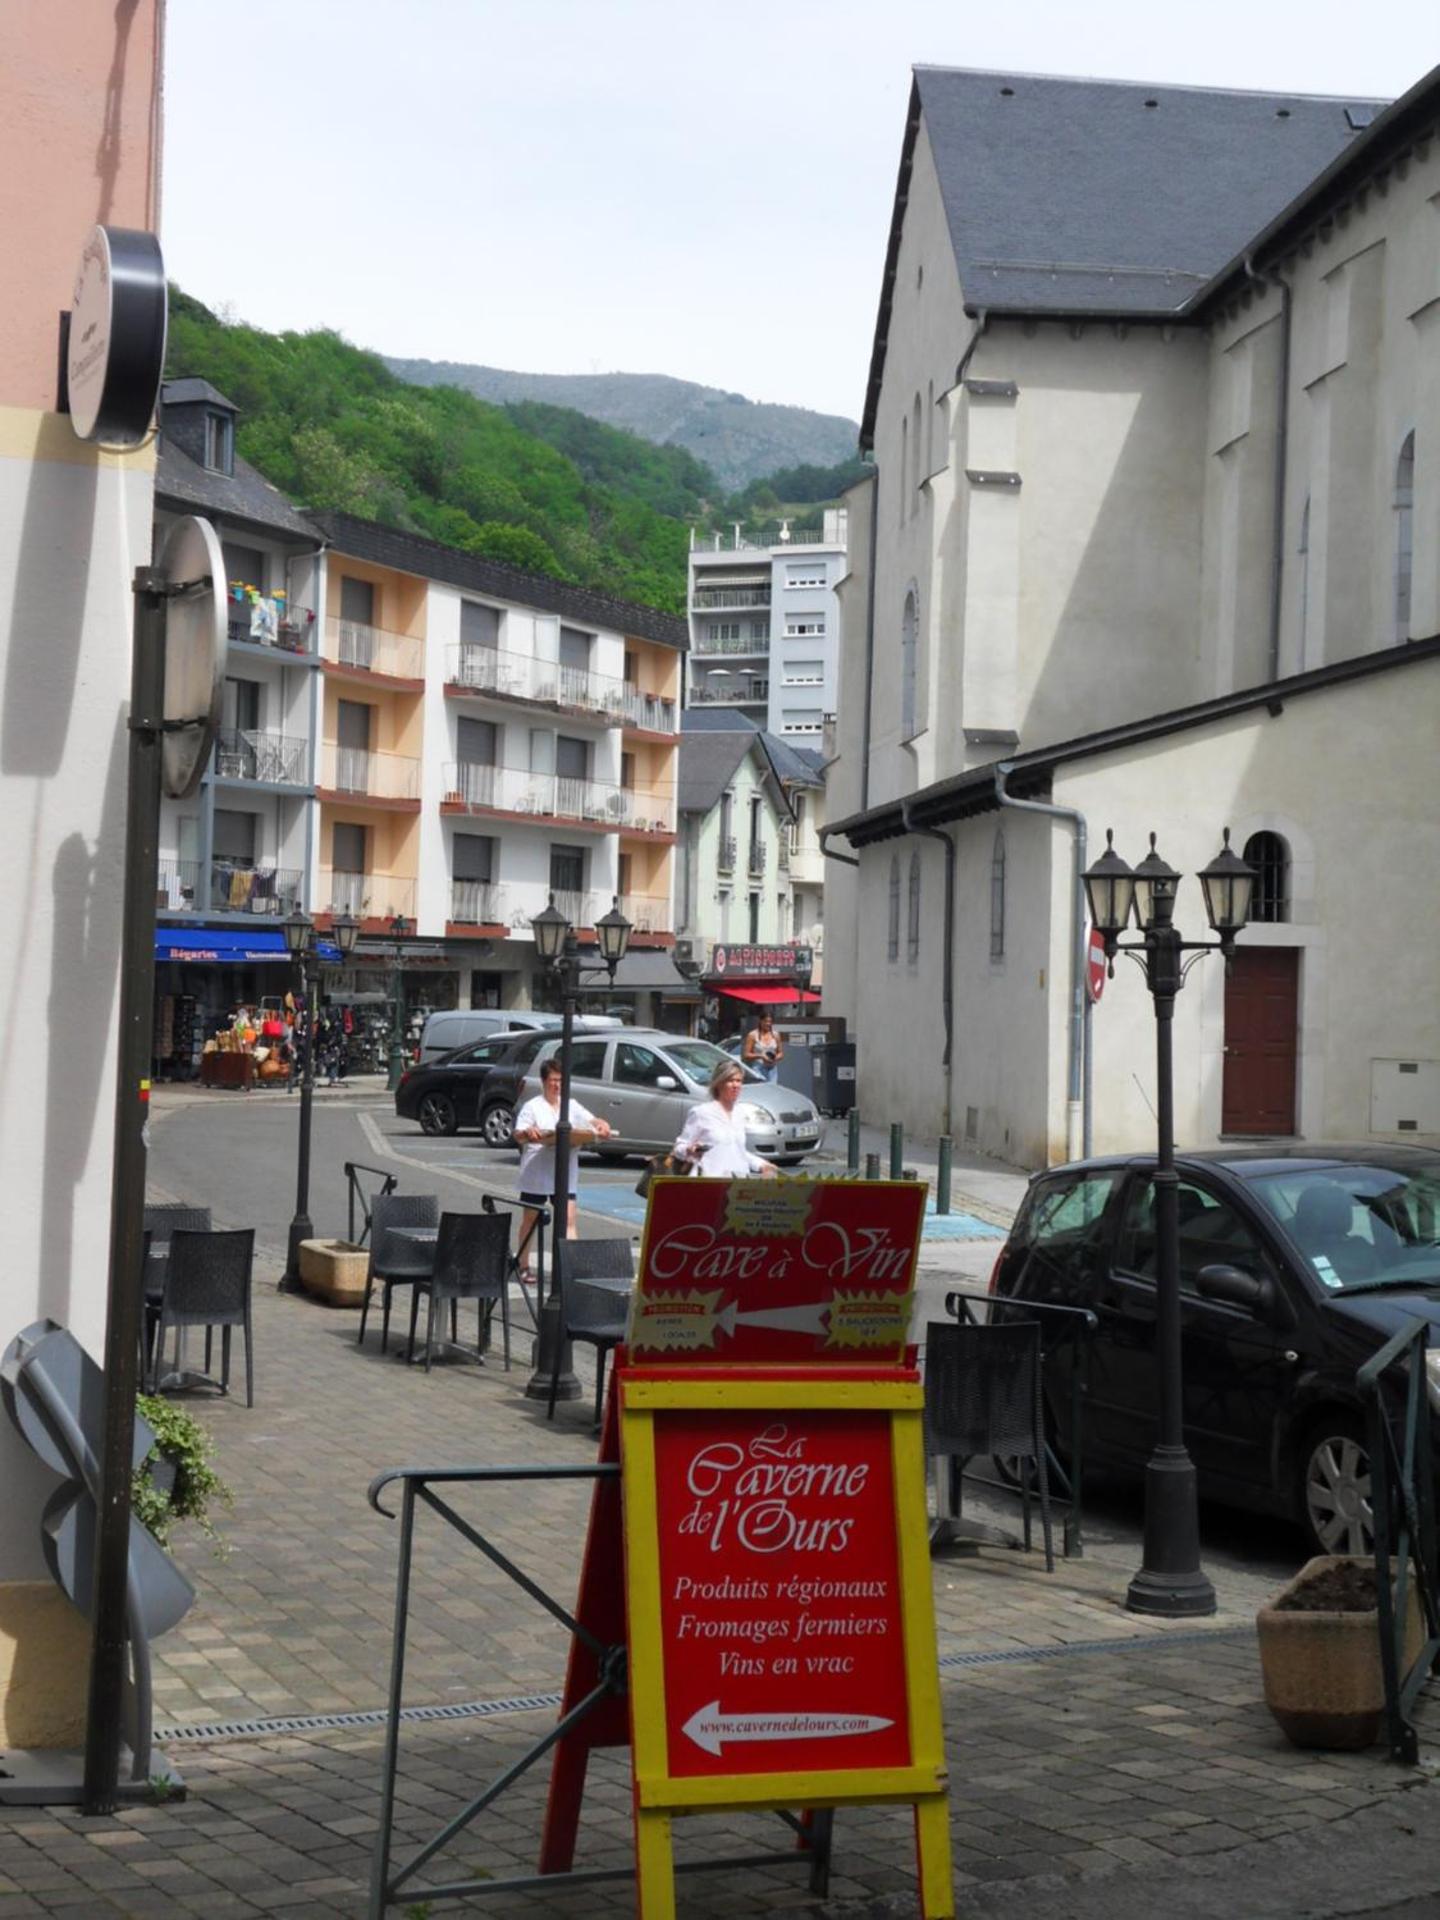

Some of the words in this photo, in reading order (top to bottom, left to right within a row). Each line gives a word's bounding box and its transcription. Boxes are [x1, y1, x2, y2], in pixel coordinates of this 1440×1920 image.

[651, 1224, 768, 1279] Cave
[768, 1250, 793, 1279] à
[801, 1222, 912, 1279] Vin
[749, 1423, 807, 1459] La
[687, 1442, 869, 1497] Caverne
[678, 1501, 711, 1535] de
[709, 1499, 855, 1553] l'Ours
[673, 1575, 769, 1600] Produits
[777, 1573, 887, 1604] régionaux
[676, 1614, 789, 1644] Fromages
[795, 1611, 888, 1643] fermiers
[719, 1651, 765, 1676] Vins
[772, 1656, 799, 1675] en
[806, 1653, 855, 1675] vrac
[699, 1714, 870, 1735] www.cavernedelours.com
